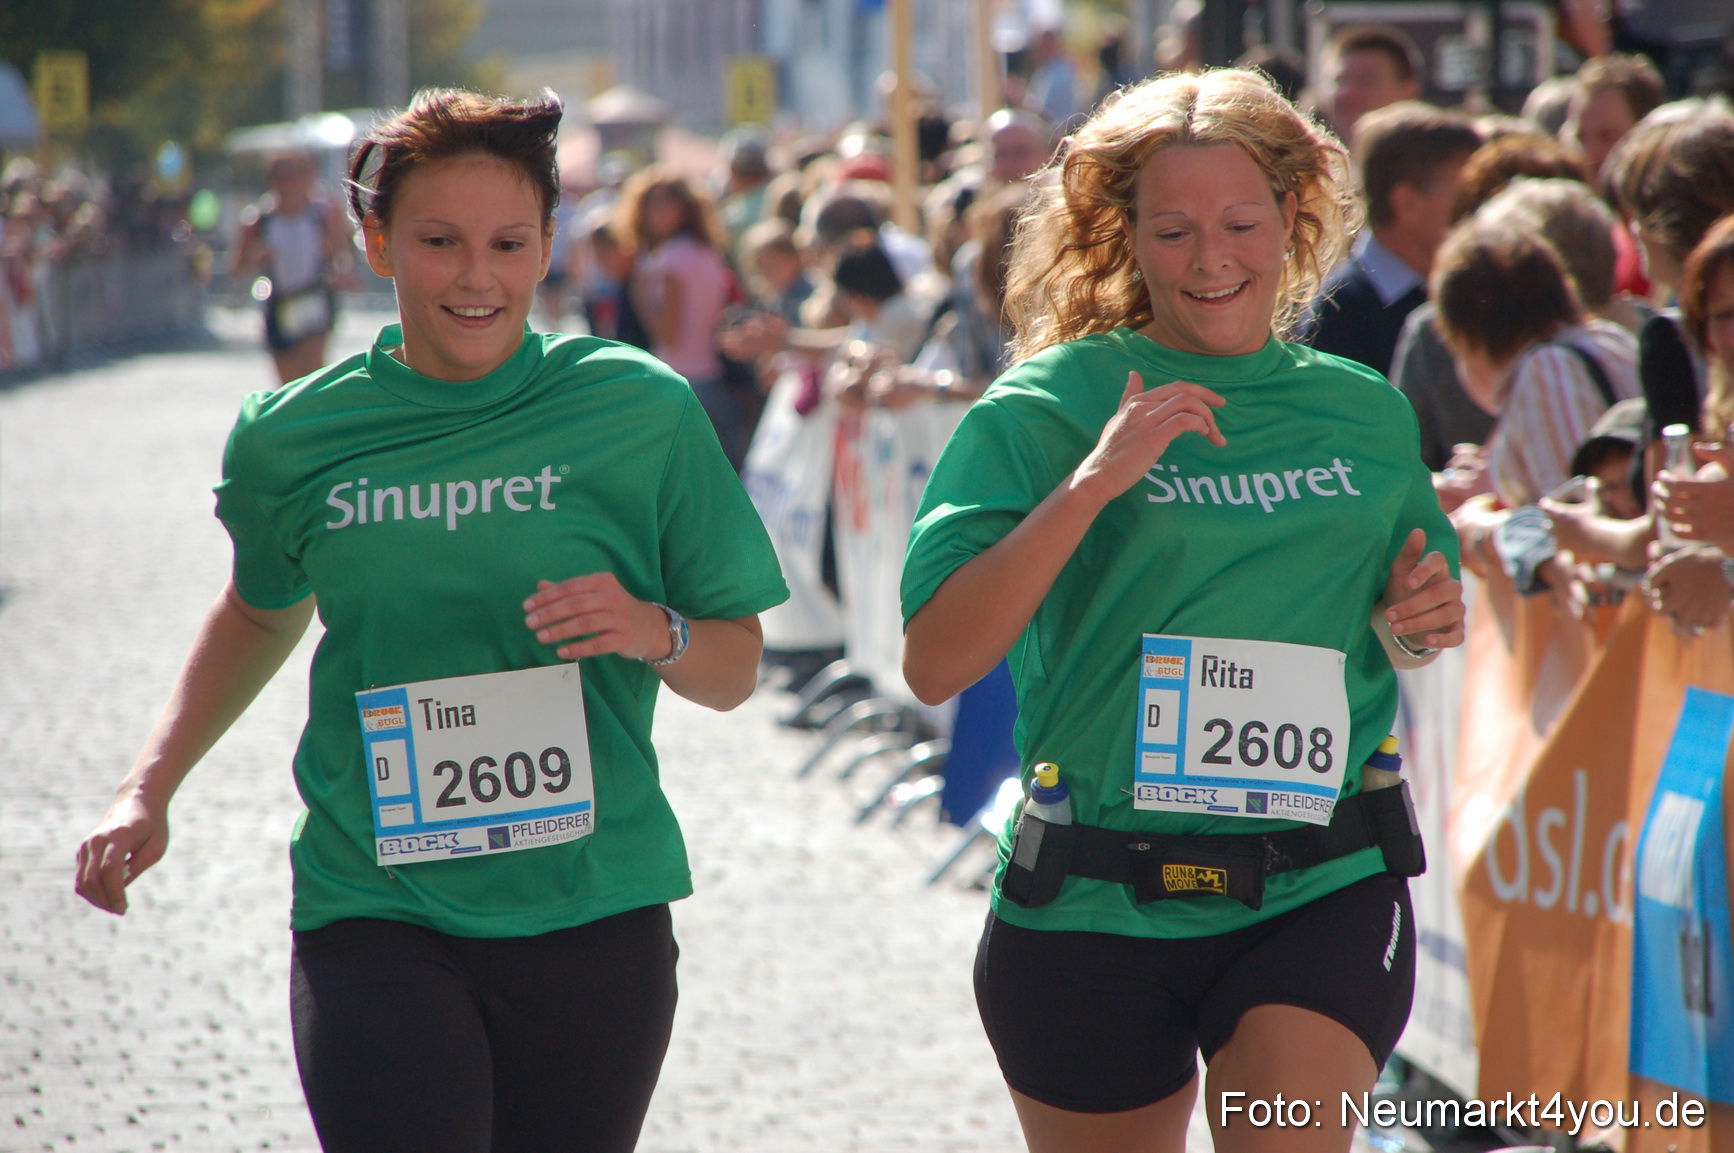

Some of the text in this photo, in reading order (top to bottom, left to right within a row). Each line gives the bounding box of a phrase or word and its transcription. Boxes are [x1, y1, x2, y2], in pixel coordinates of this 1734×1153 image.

[1201, 654, 1254, 690] Rita
[418, 698, 476, 731] Tina
[1148, 704, 1161, 728] D
[1201, 718, 1334, 774] 2608
[376, 757, 389, 781] D
[433, 747, 571, 808] 2609
[1138, 785, 1218, 804] BOCK
[512, 812, 590, 838] PFLEIDERER
[379, 832, 460, 856] BOCK
[1166, 879, 1198, 890] MOVE
